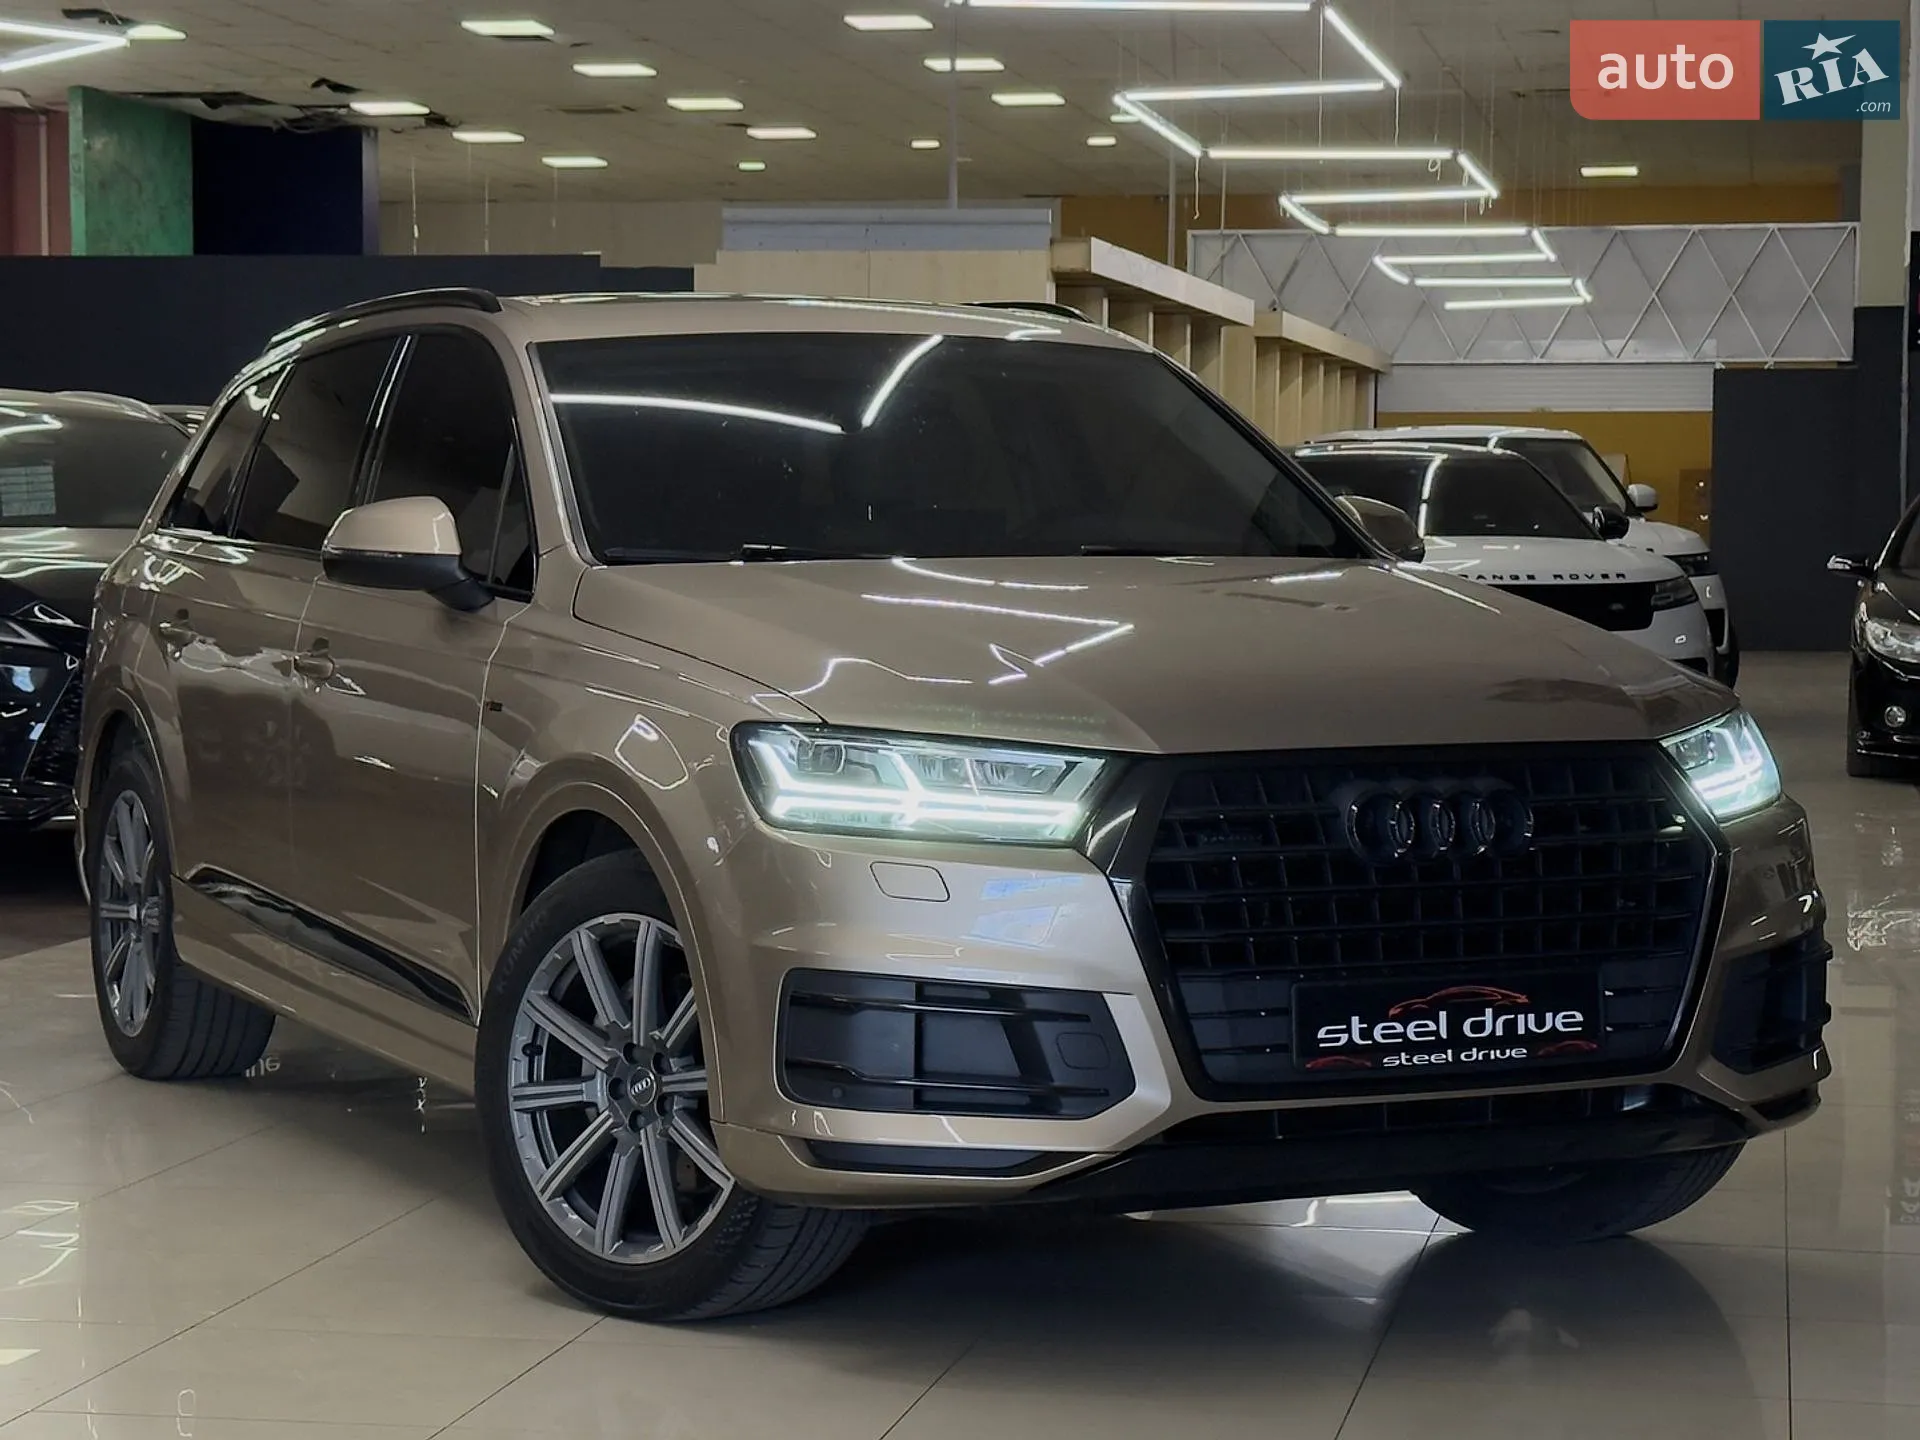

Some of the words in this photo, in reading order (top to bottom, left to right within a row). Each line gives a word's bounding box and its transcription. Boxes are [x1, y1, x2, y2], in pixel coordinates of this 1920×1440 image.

[1552, 572, 1627, 581] ROVER
[1317, 1010, 1448, 1048] steel
[1462, 1007, 1585, 1038] drive
[1382, 1048, 1453, 1067] steel
[1459, 1046, 1528, 1061] drive
